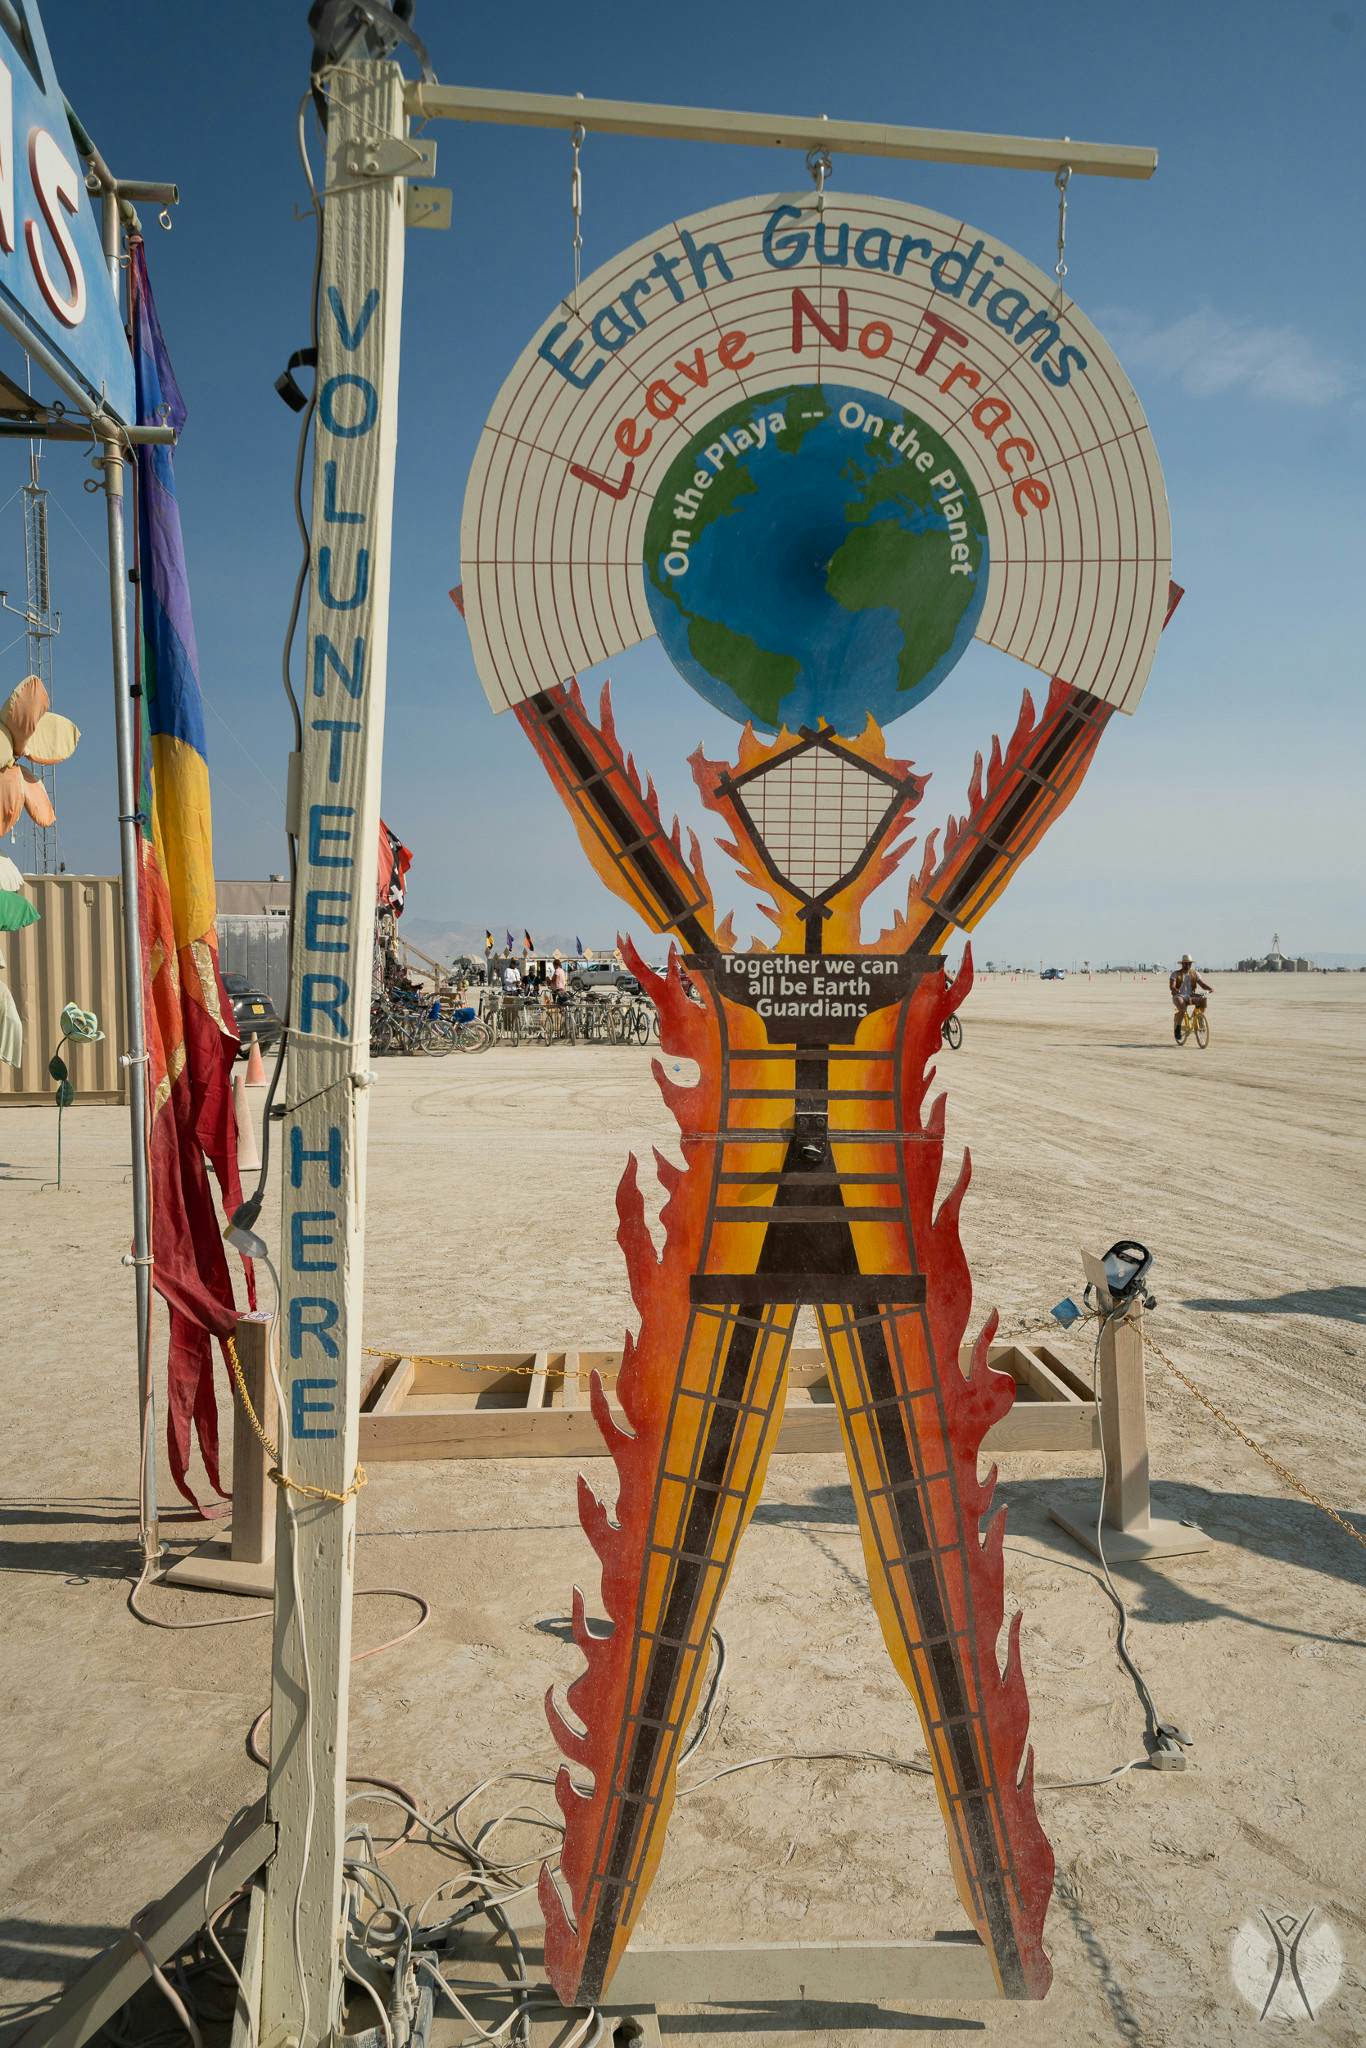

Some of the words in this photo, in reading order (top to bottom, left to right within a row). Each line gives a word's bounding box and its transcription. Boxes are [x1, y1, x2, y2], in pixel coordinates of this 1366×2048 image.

[0, 57, 87, 328] S
[537, 229, 733, 390] Earth
[762, 204, 1087, 388] Guardians
[570, 330, 755, 501] Leave
[791, 288, 894, 359] No
[914, 310, 1051, 518] Trace
[838, 401, 885, 437] On
[703, 412, 788, 471] Playa
[889, 423, 936, 473] the
[673, 467, 714, 521] the
[930, 468, 974, 577] Planet
[664, 528, 691, 577] On
[301, 285, 381, 1037] VOLUNTEER
[721, 954, 820, 978] Together
[824, 959, 856, 974] we
[861, 959, 899, 975] can
[748, 977, 774, 996] all
[780, 976, 807, 996] be
[813, 976, 871, 996] Earth
[756, 998, 868, 1018] Guardians
[289, 1125, 342, 1440] HERE
